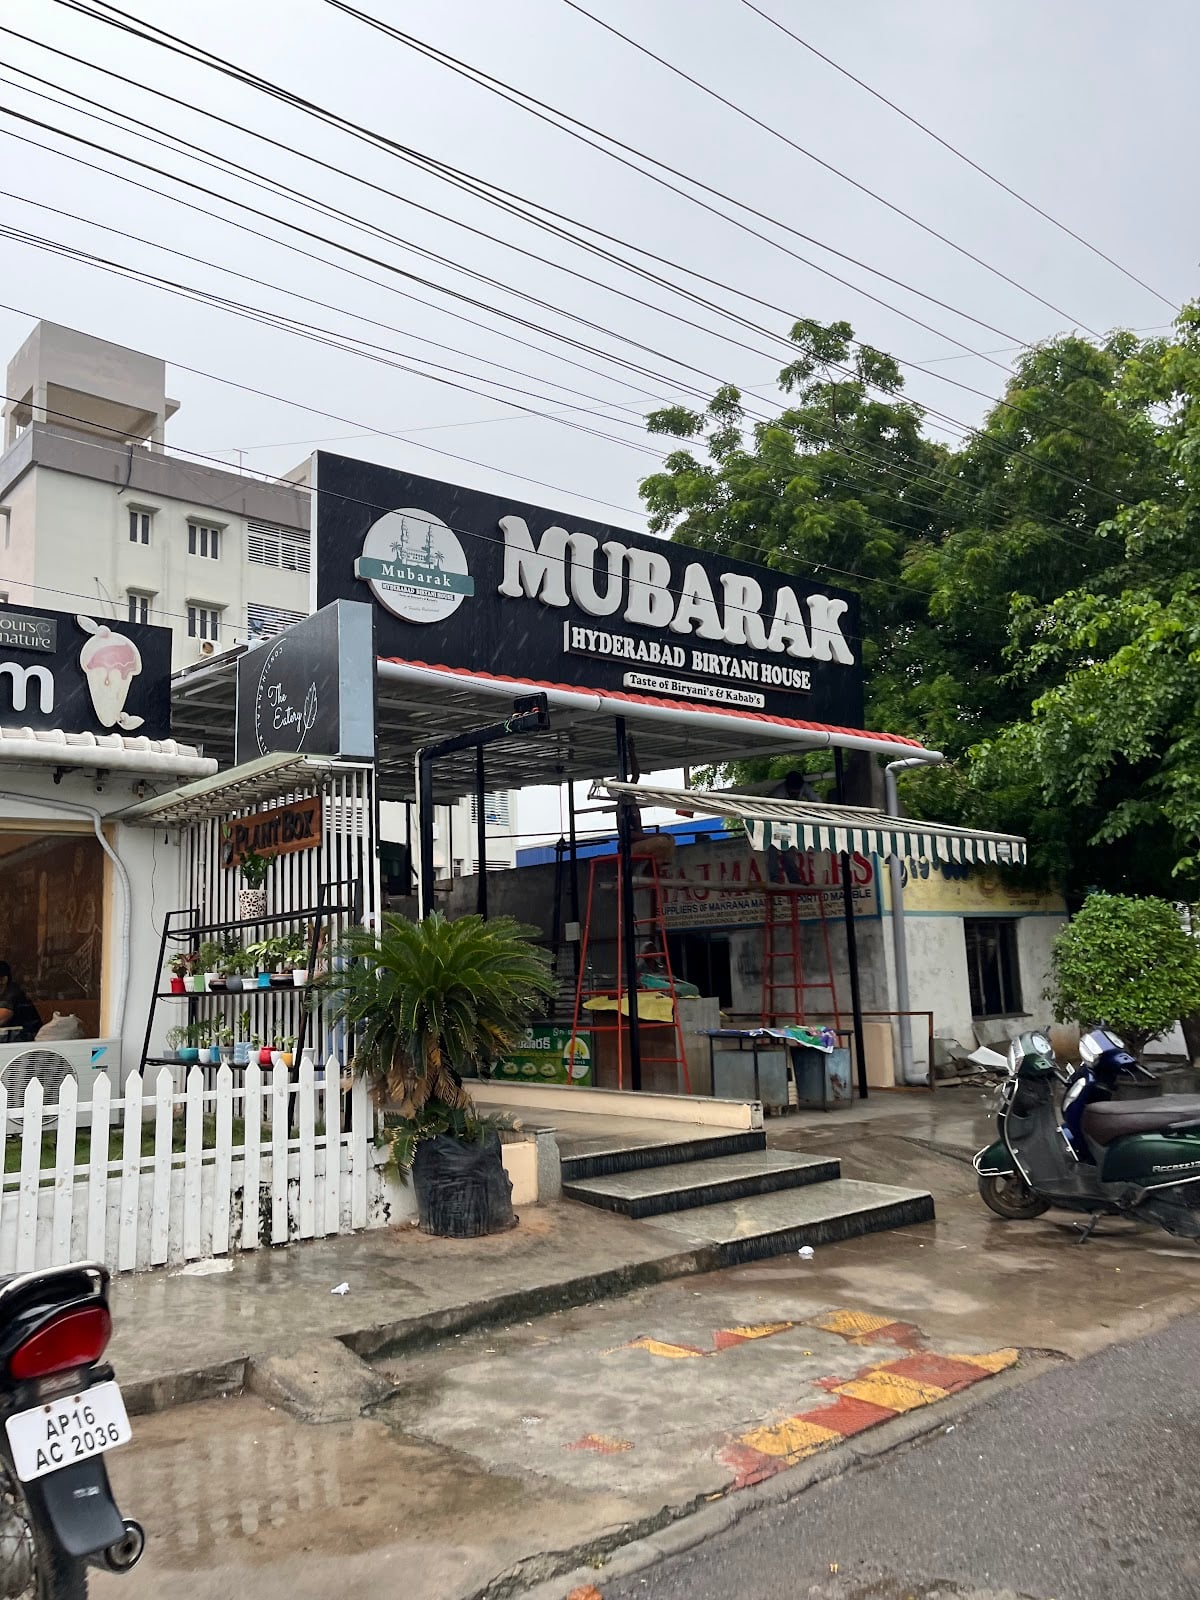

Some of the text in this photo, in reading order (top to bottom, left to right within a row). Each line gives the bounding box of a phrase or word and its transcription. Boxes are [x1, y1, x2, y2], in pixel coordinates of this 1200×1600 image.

[381, 563, 452, 587] Mubarak
[497, 515, 855, 665] MUBARAK
[571, 626, 811, 690] HYDERABAD BIRYANI HOUSE
[267, 682, 288, 706] The
[630, 674, 761, 705] Taste of Biryani's & Kabab's
[273, 706, 303, 733] Eatery
[235, 809, 315, 852] PLANT BOX
[46, 1405, 95, 1440] AP16
[36, 1422, 119, 1470] AC 2036
